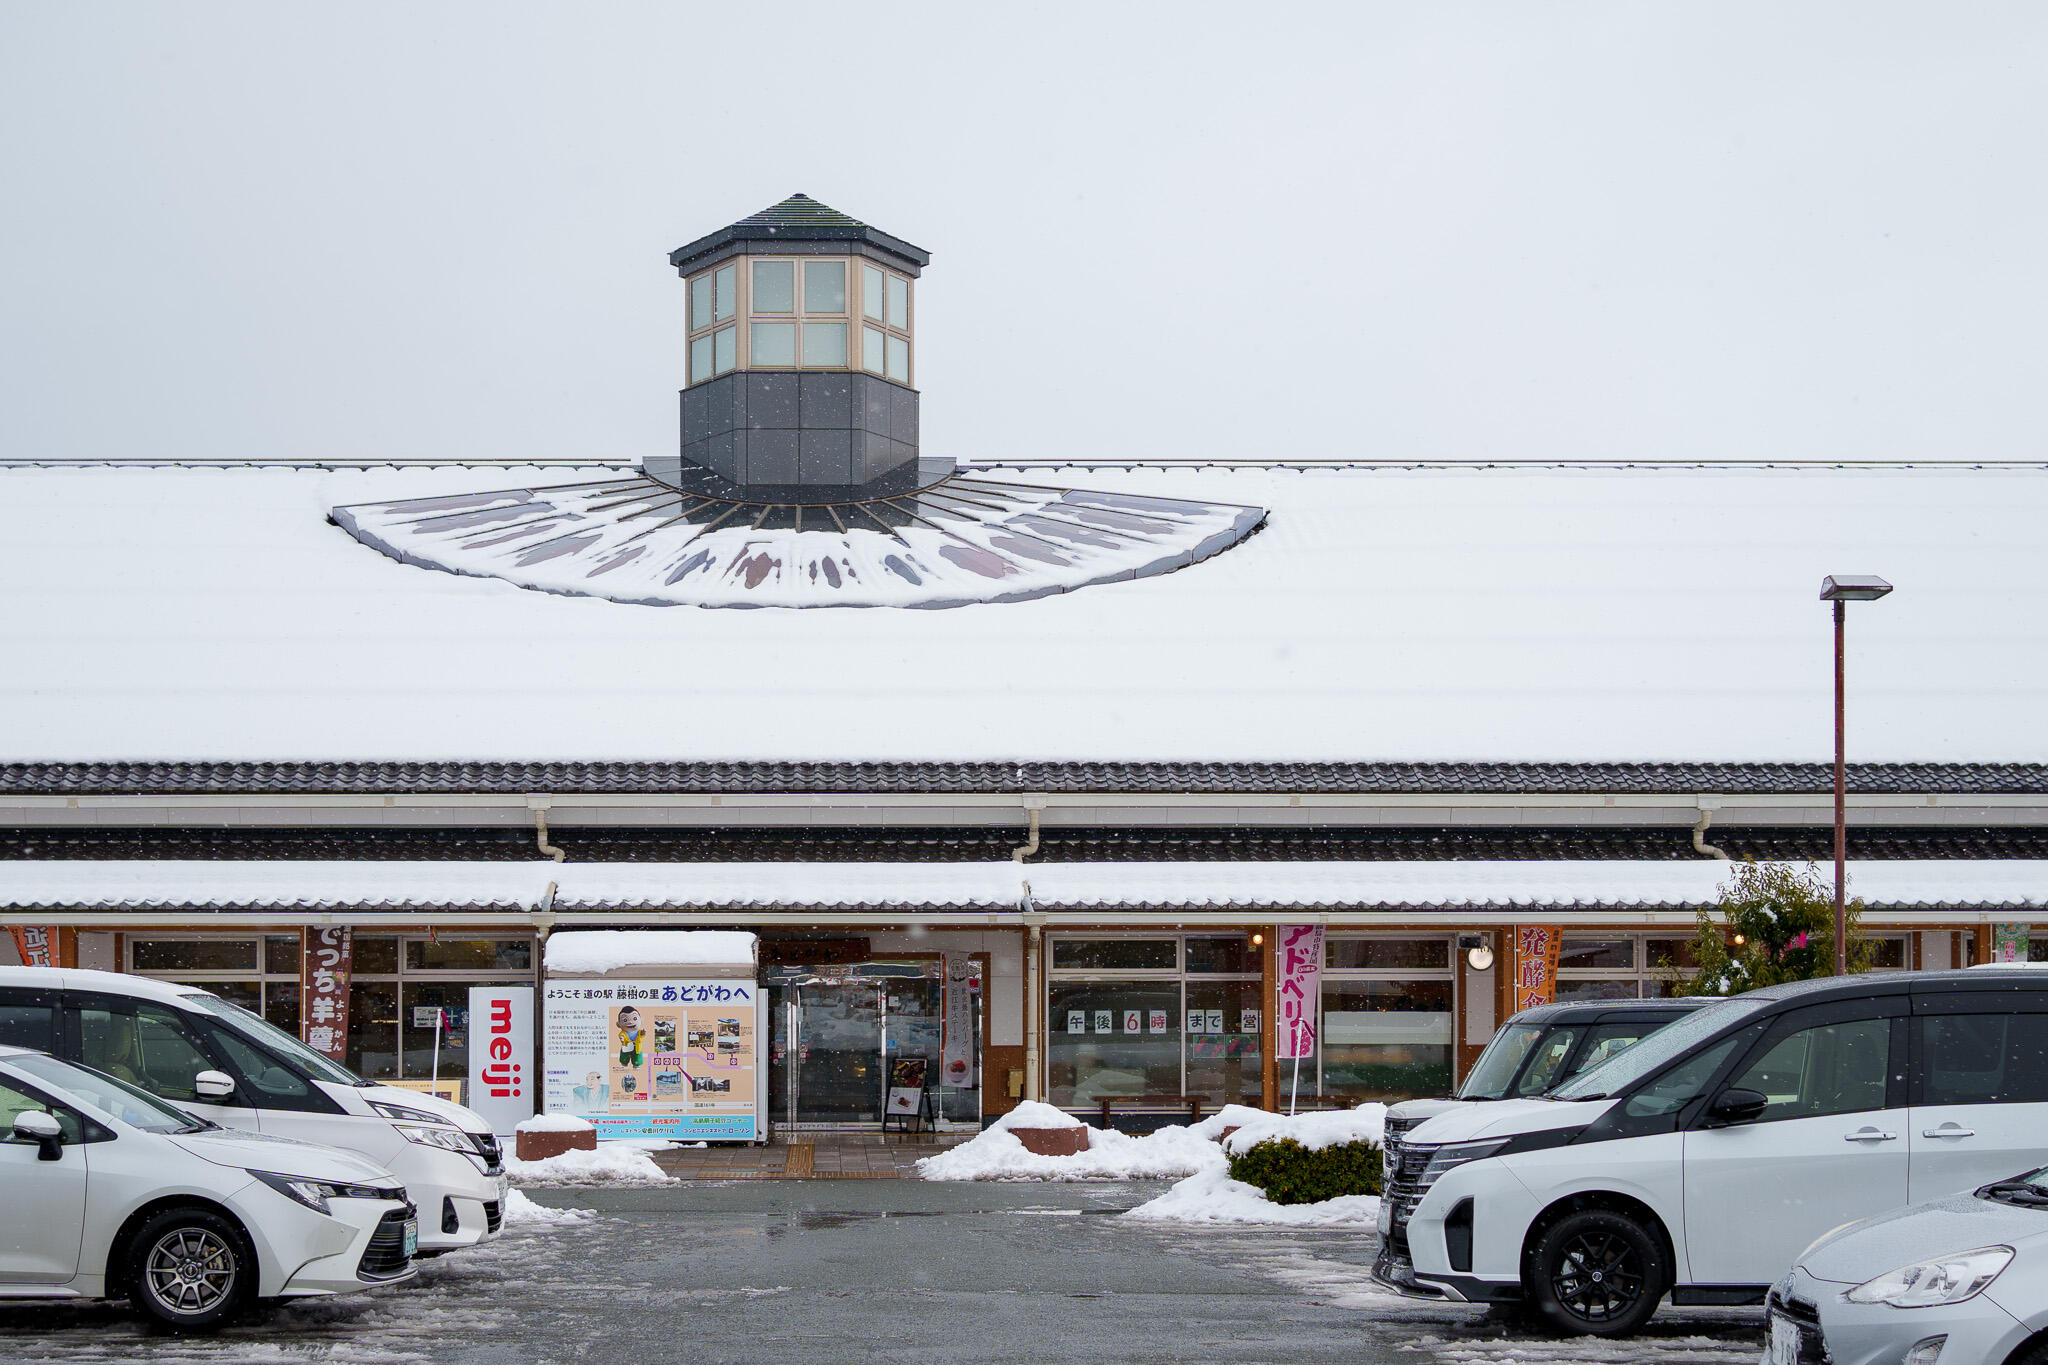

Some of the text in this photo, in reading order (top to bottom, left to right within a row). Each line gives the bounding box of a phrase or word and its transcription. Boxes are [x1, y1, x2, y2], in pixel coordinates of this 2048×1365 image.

[547, 985, 750, 1002] ようこそ 道の駅 藤樹の里 あどがわへ
[482, 999, 521, 1098] meiji
